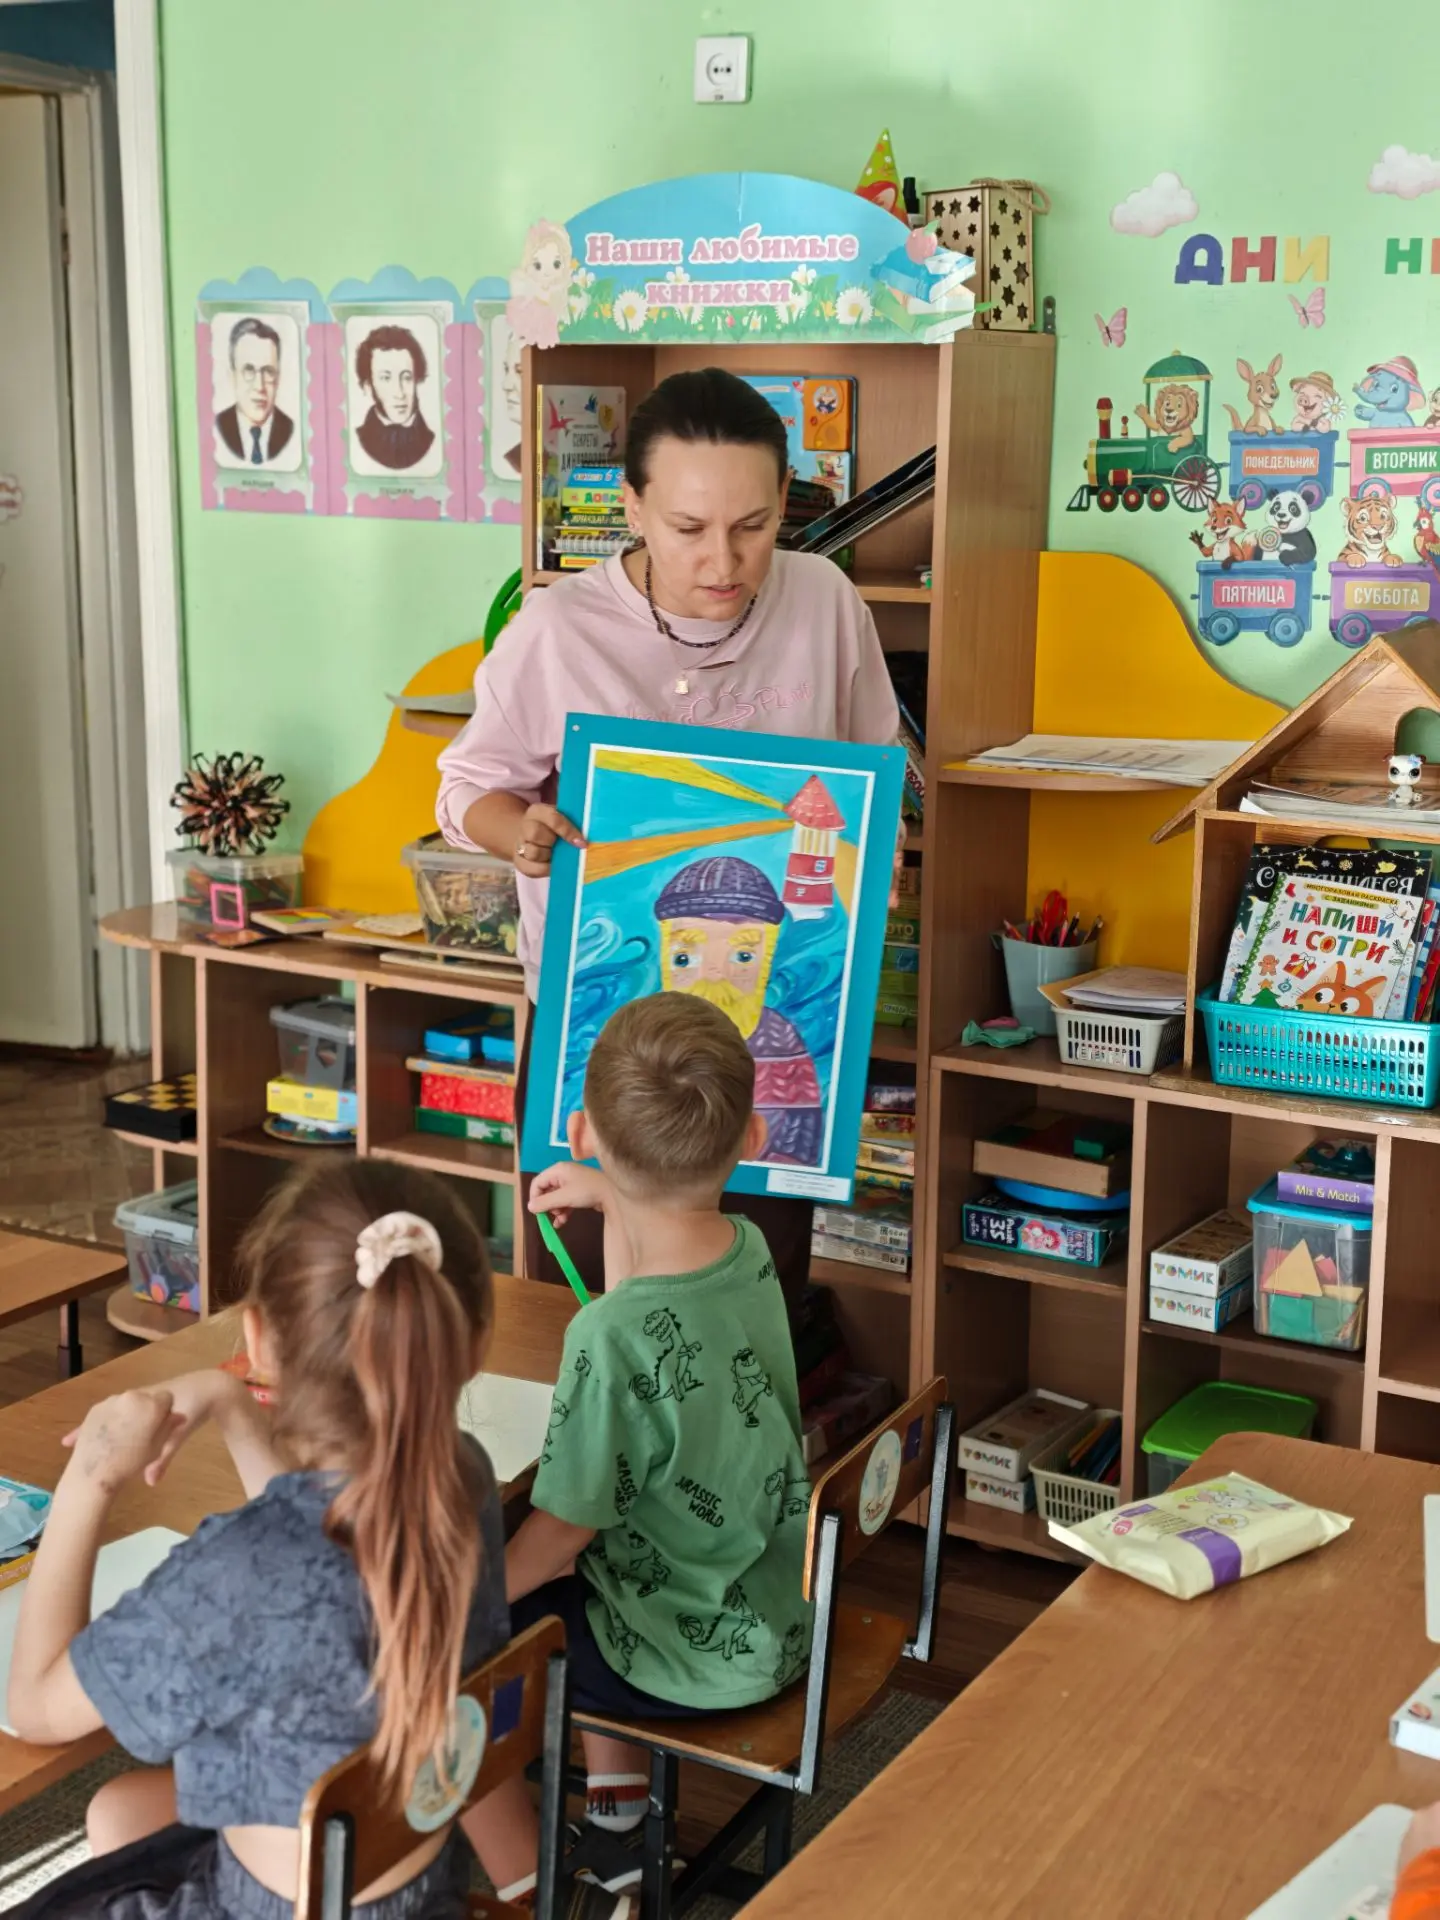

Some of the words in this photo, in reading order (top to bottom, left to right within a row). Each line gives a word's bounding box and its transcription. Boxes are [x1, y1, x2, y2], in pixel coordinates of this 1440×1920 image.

[586, 234, 682, 264] Наши
[691, 224, 858, 262] любимые
[1174, 233, 1330, 285] ДНИ
[646, 282, 791, 305] книжки
[1245, 453, 1316, 470] ПОНЕДЕЛЬНИК
[1372, 451, 1438, 469] ВТОРНИК
[1220, 584, 1286, 604] ПЯТНИЦА
[1353, 587, 1420, 606] СУББОТА
[1360, 891, 1398, 905] РАСКРАСКА
[1289, 902, 1395, 939] НАПИШИ
[1282, 927, 1299, 946] И
[1305, 930, 1390, 964] СОТРИ
[1295, 1184, 1314, 1197] Mix
[1316, 1187, 1325, 1198] &
[1327, 1189, 1361, 1204] Match
[989, 1218, 1005, 1241] 35
[1153, 1262, 1215, 1285] ТОМИК
[1153, 1295, 1213, 1319] ТОМИК
[963, 1447, 1012, 1469] ТОМИК
[968, 1478, 1020, 1502] ТОМИК
[688, 1500, 724, 1528] WORLD
